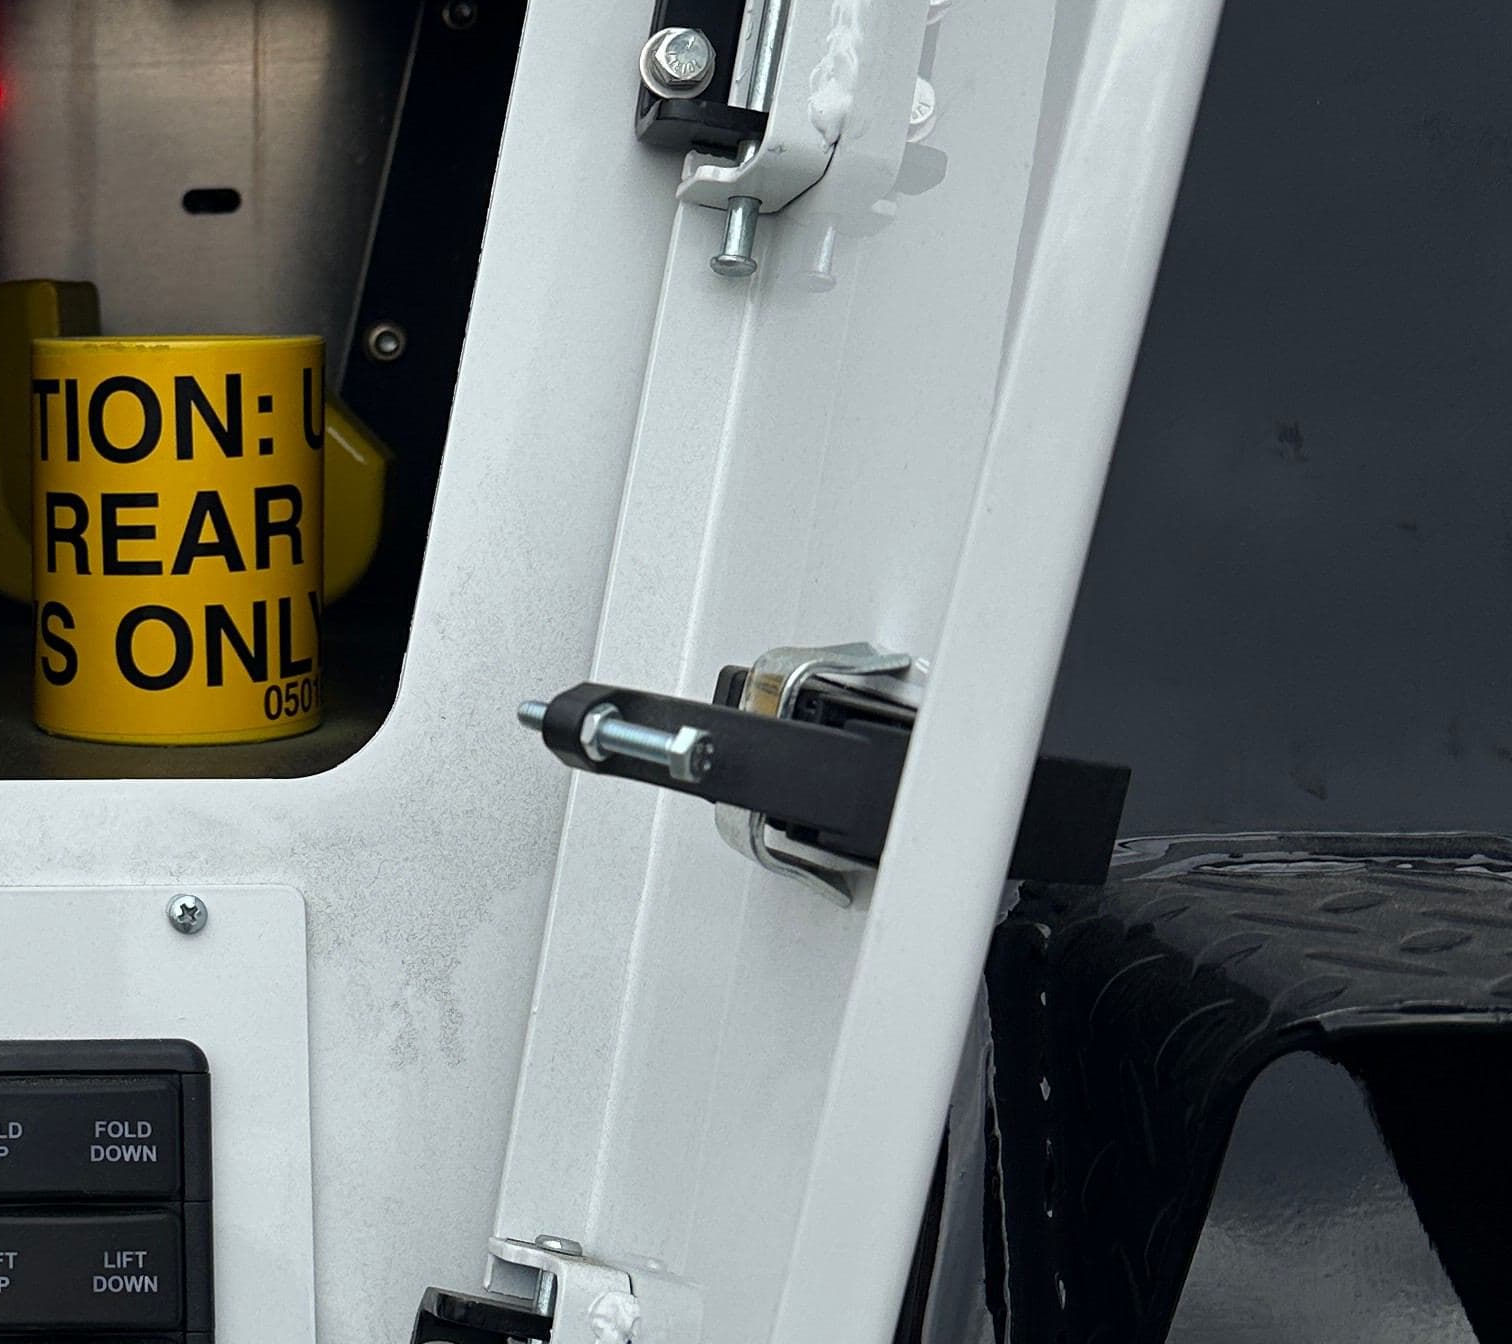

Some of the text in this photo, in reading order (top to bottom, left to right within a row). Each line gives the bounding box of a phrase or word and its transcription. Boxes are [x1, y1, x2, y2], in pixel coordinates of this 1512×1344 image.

[32, 373, 274, 464] TION:
[45, 484, 305, 576] REAR
[33, 599, 79, 687] S
[94, 1120, 153, 1138] FOLD
[89, 1145, 158, 1162] DOWN
[103, 1251, 148, 1269] LIFT
[92, 1275, 159, 1293] DOWN
